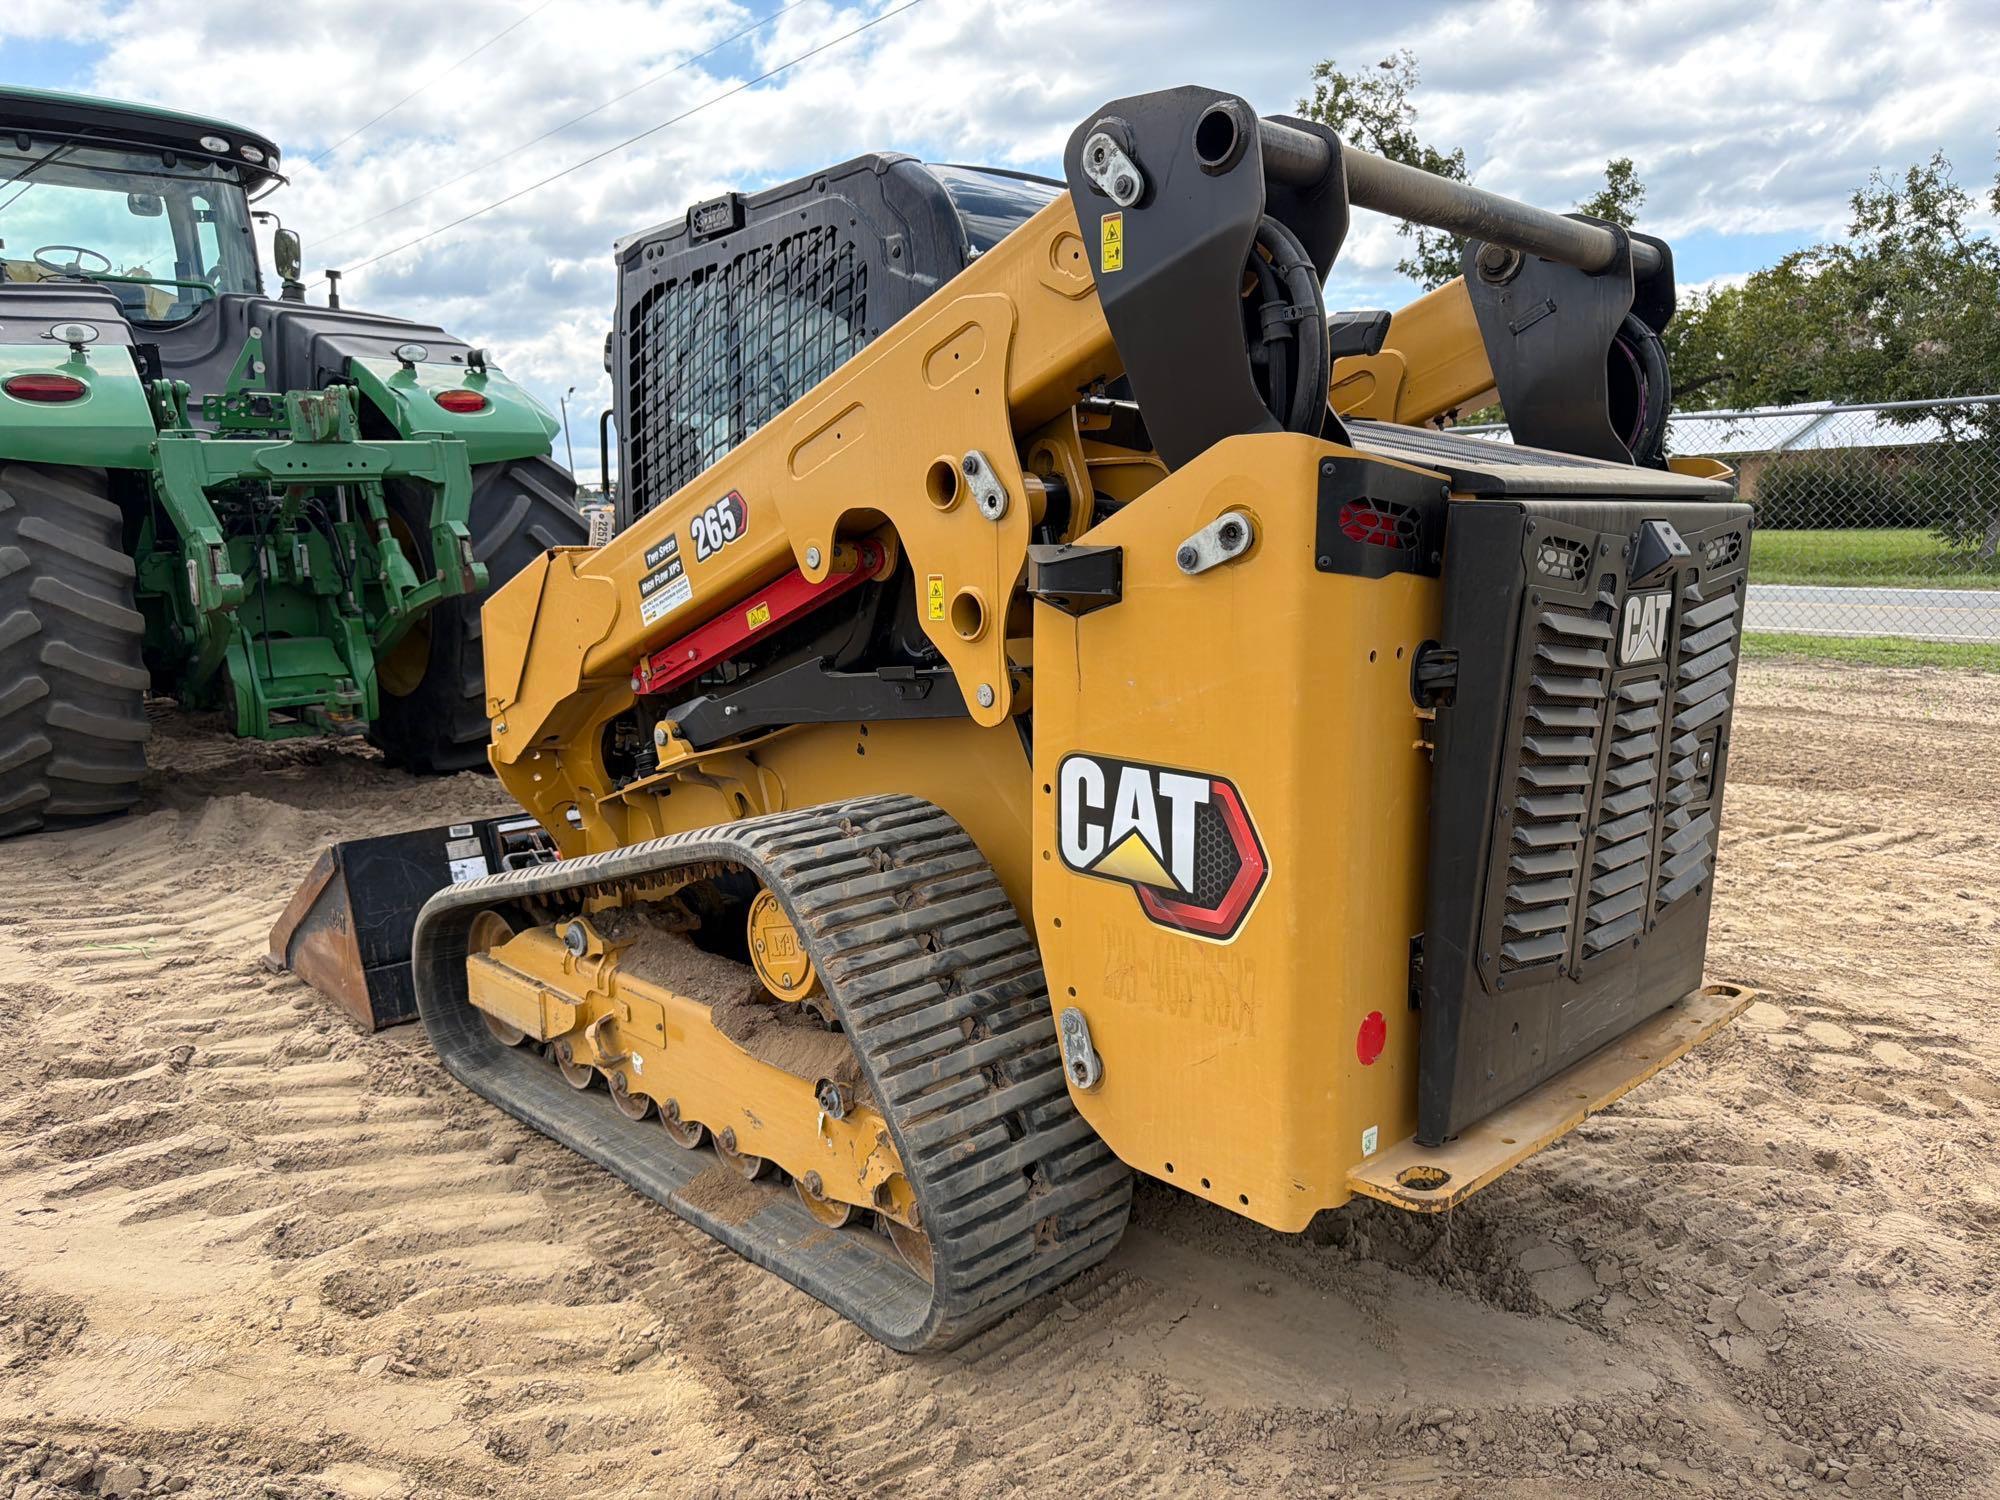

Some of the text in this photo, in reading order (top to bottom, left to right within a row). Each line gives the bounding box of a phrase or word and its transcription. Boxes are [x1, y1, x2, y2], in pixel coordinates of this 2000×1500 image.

[691, 497, 738, 561] 265
[668, 560, 681, 577] XPS
[1621, 594, 1672, 664] CAT
[1060, 756, 1210, 895] CAT
